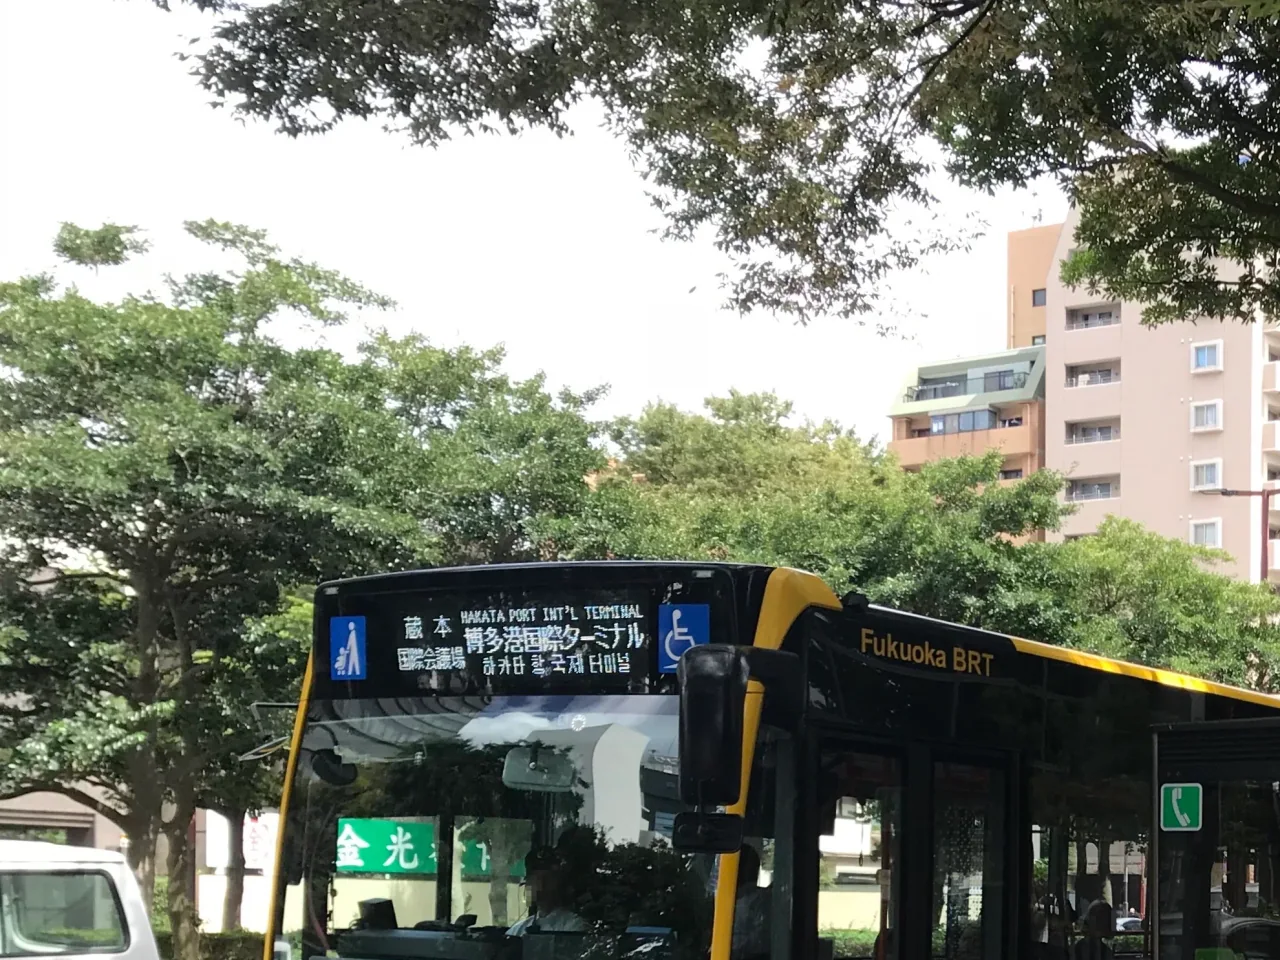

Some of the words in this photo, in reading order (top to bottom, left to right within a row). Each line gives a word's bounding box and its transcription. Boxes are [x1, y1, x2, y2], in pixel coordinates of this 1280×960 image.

[460, 609, 506, 624] HAKATA
[508, 607, 537, 622] PORT
[584, 604, 644, 620] TERMINAL
[463, 624, 645, 654] 博多港国際ターミナル
[860, 628, 947, 668] Fukuoka
[953, 647, 994, 677] BRT
